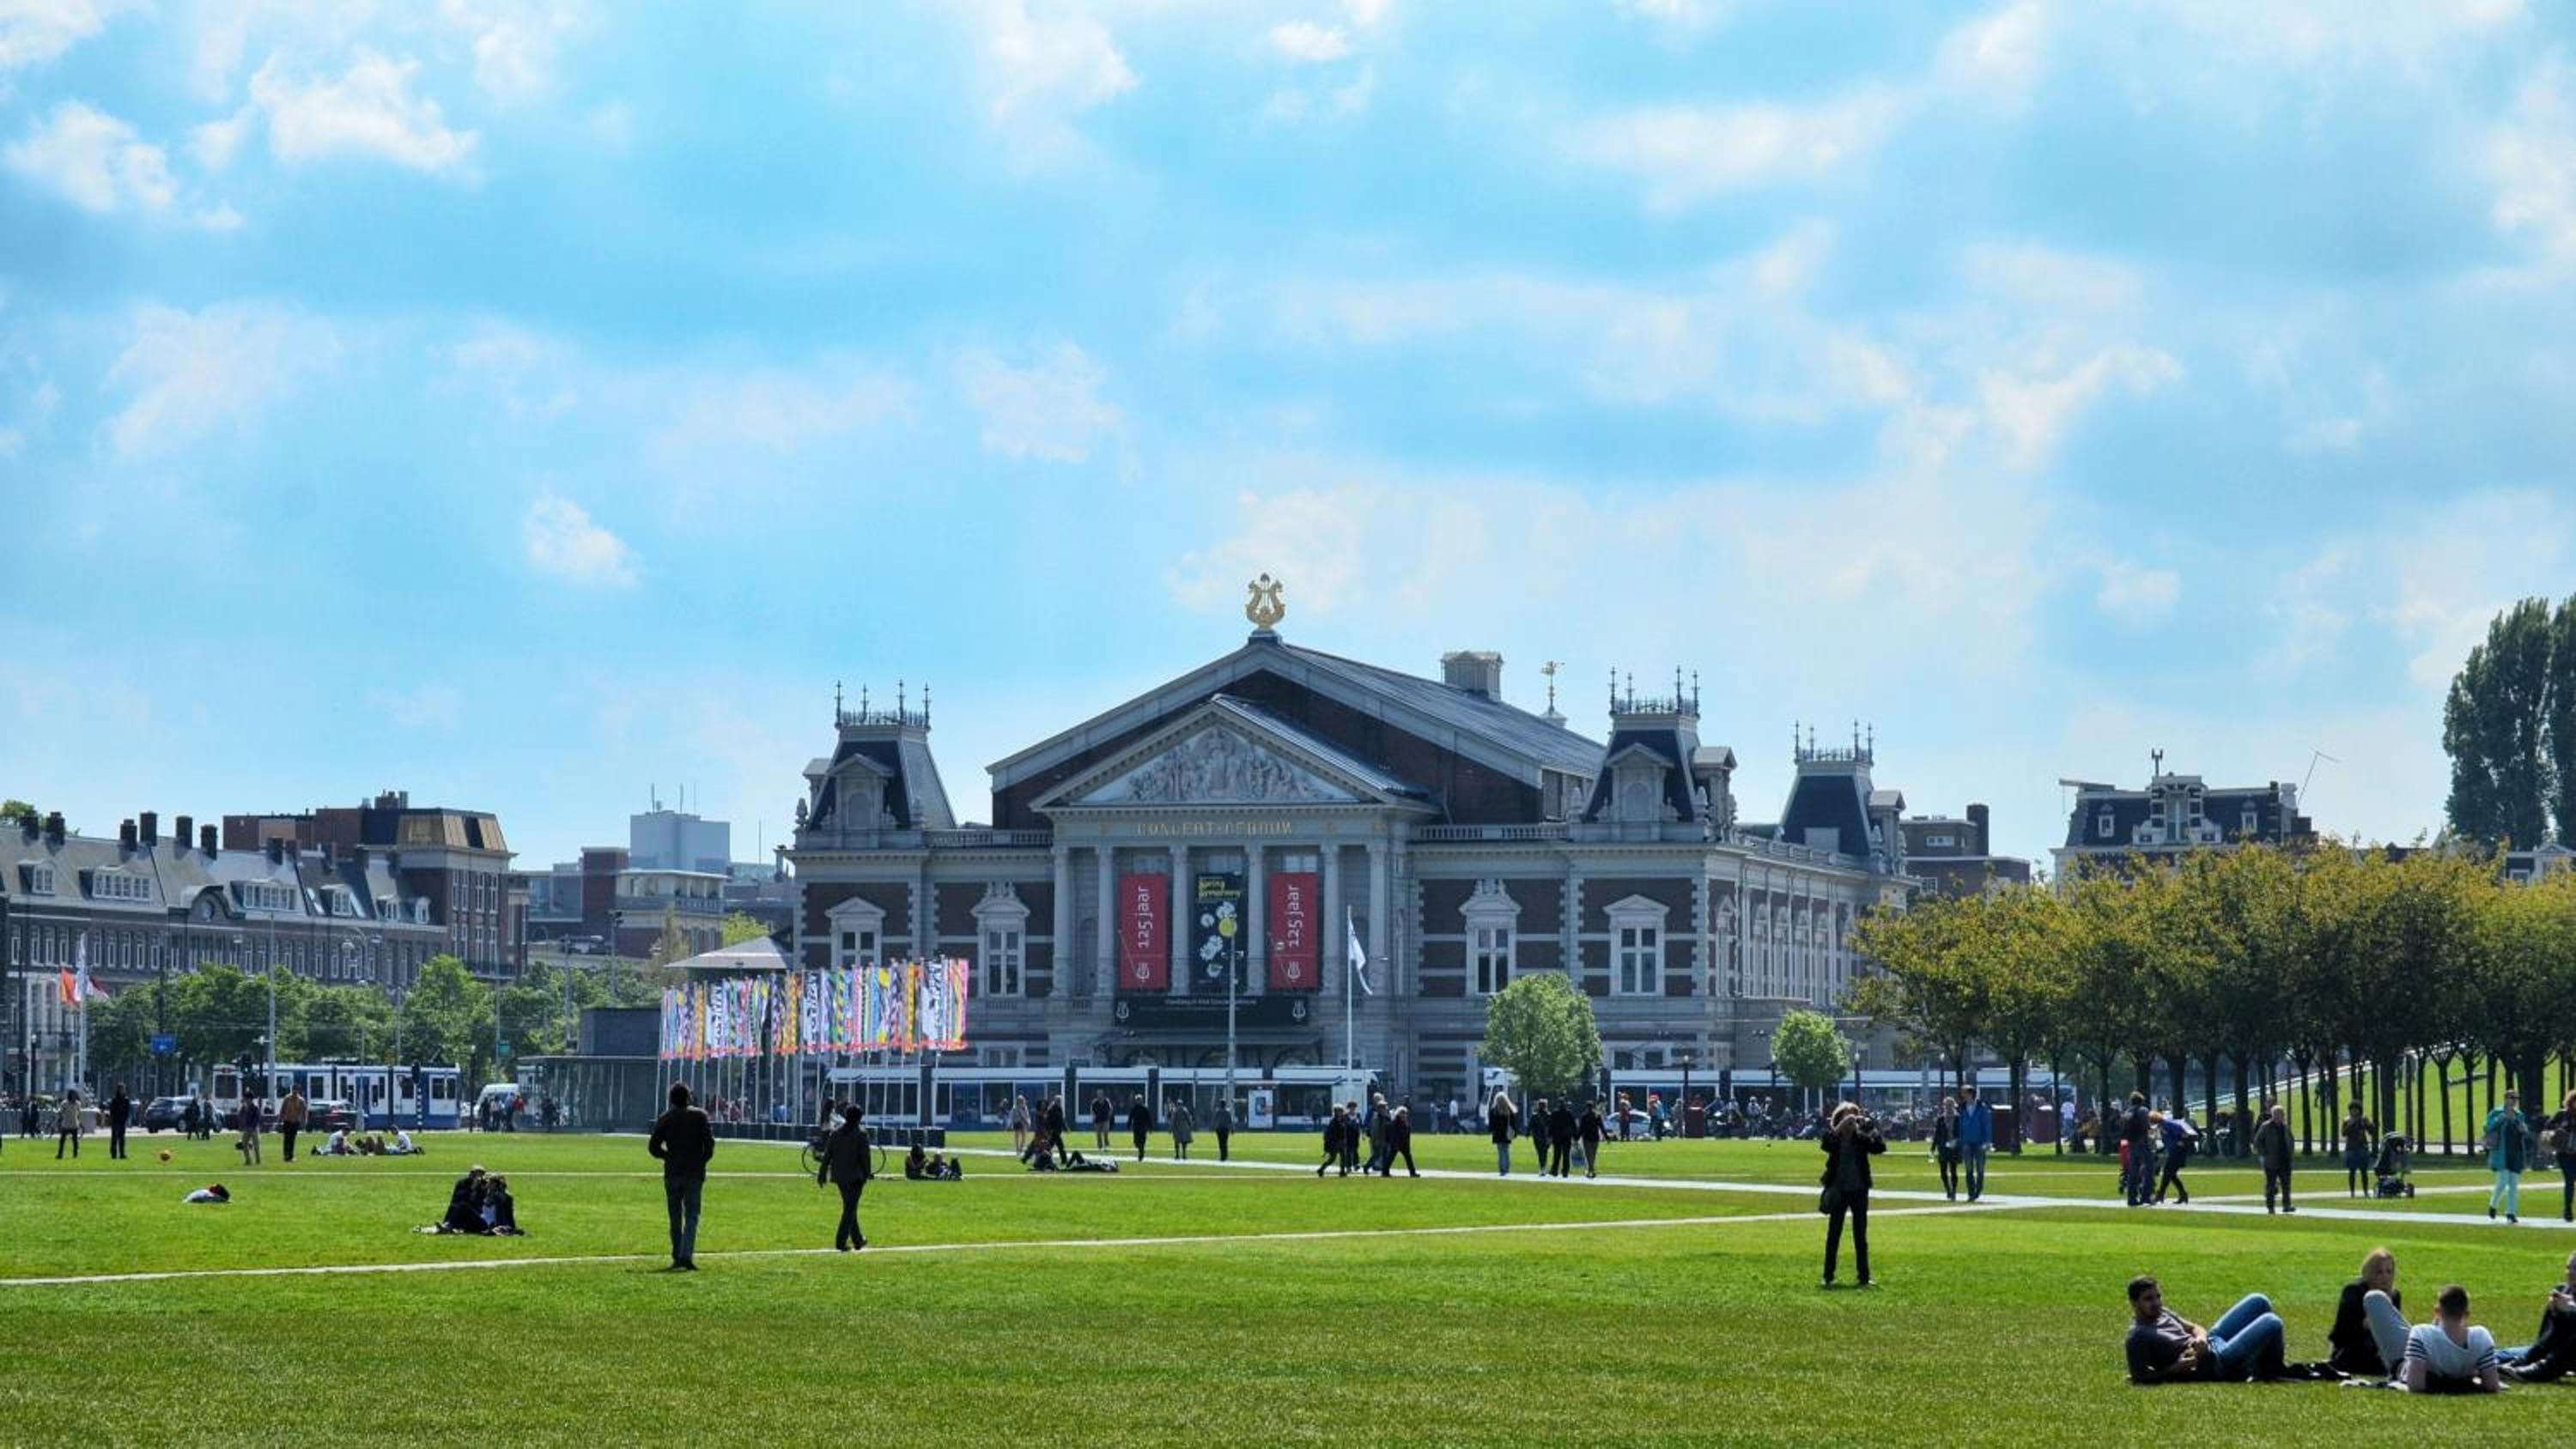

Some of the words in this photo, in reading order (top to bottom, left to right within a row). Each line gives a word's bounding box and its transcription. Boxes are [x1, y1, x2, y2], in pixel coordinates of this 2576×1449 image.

[1136, 885, 1153, 919] jaar
[1287, 884, 1304, 919] jaar
[1138, 921, 1153, 949] 125
[1287, 920, 1303, 949] 125
